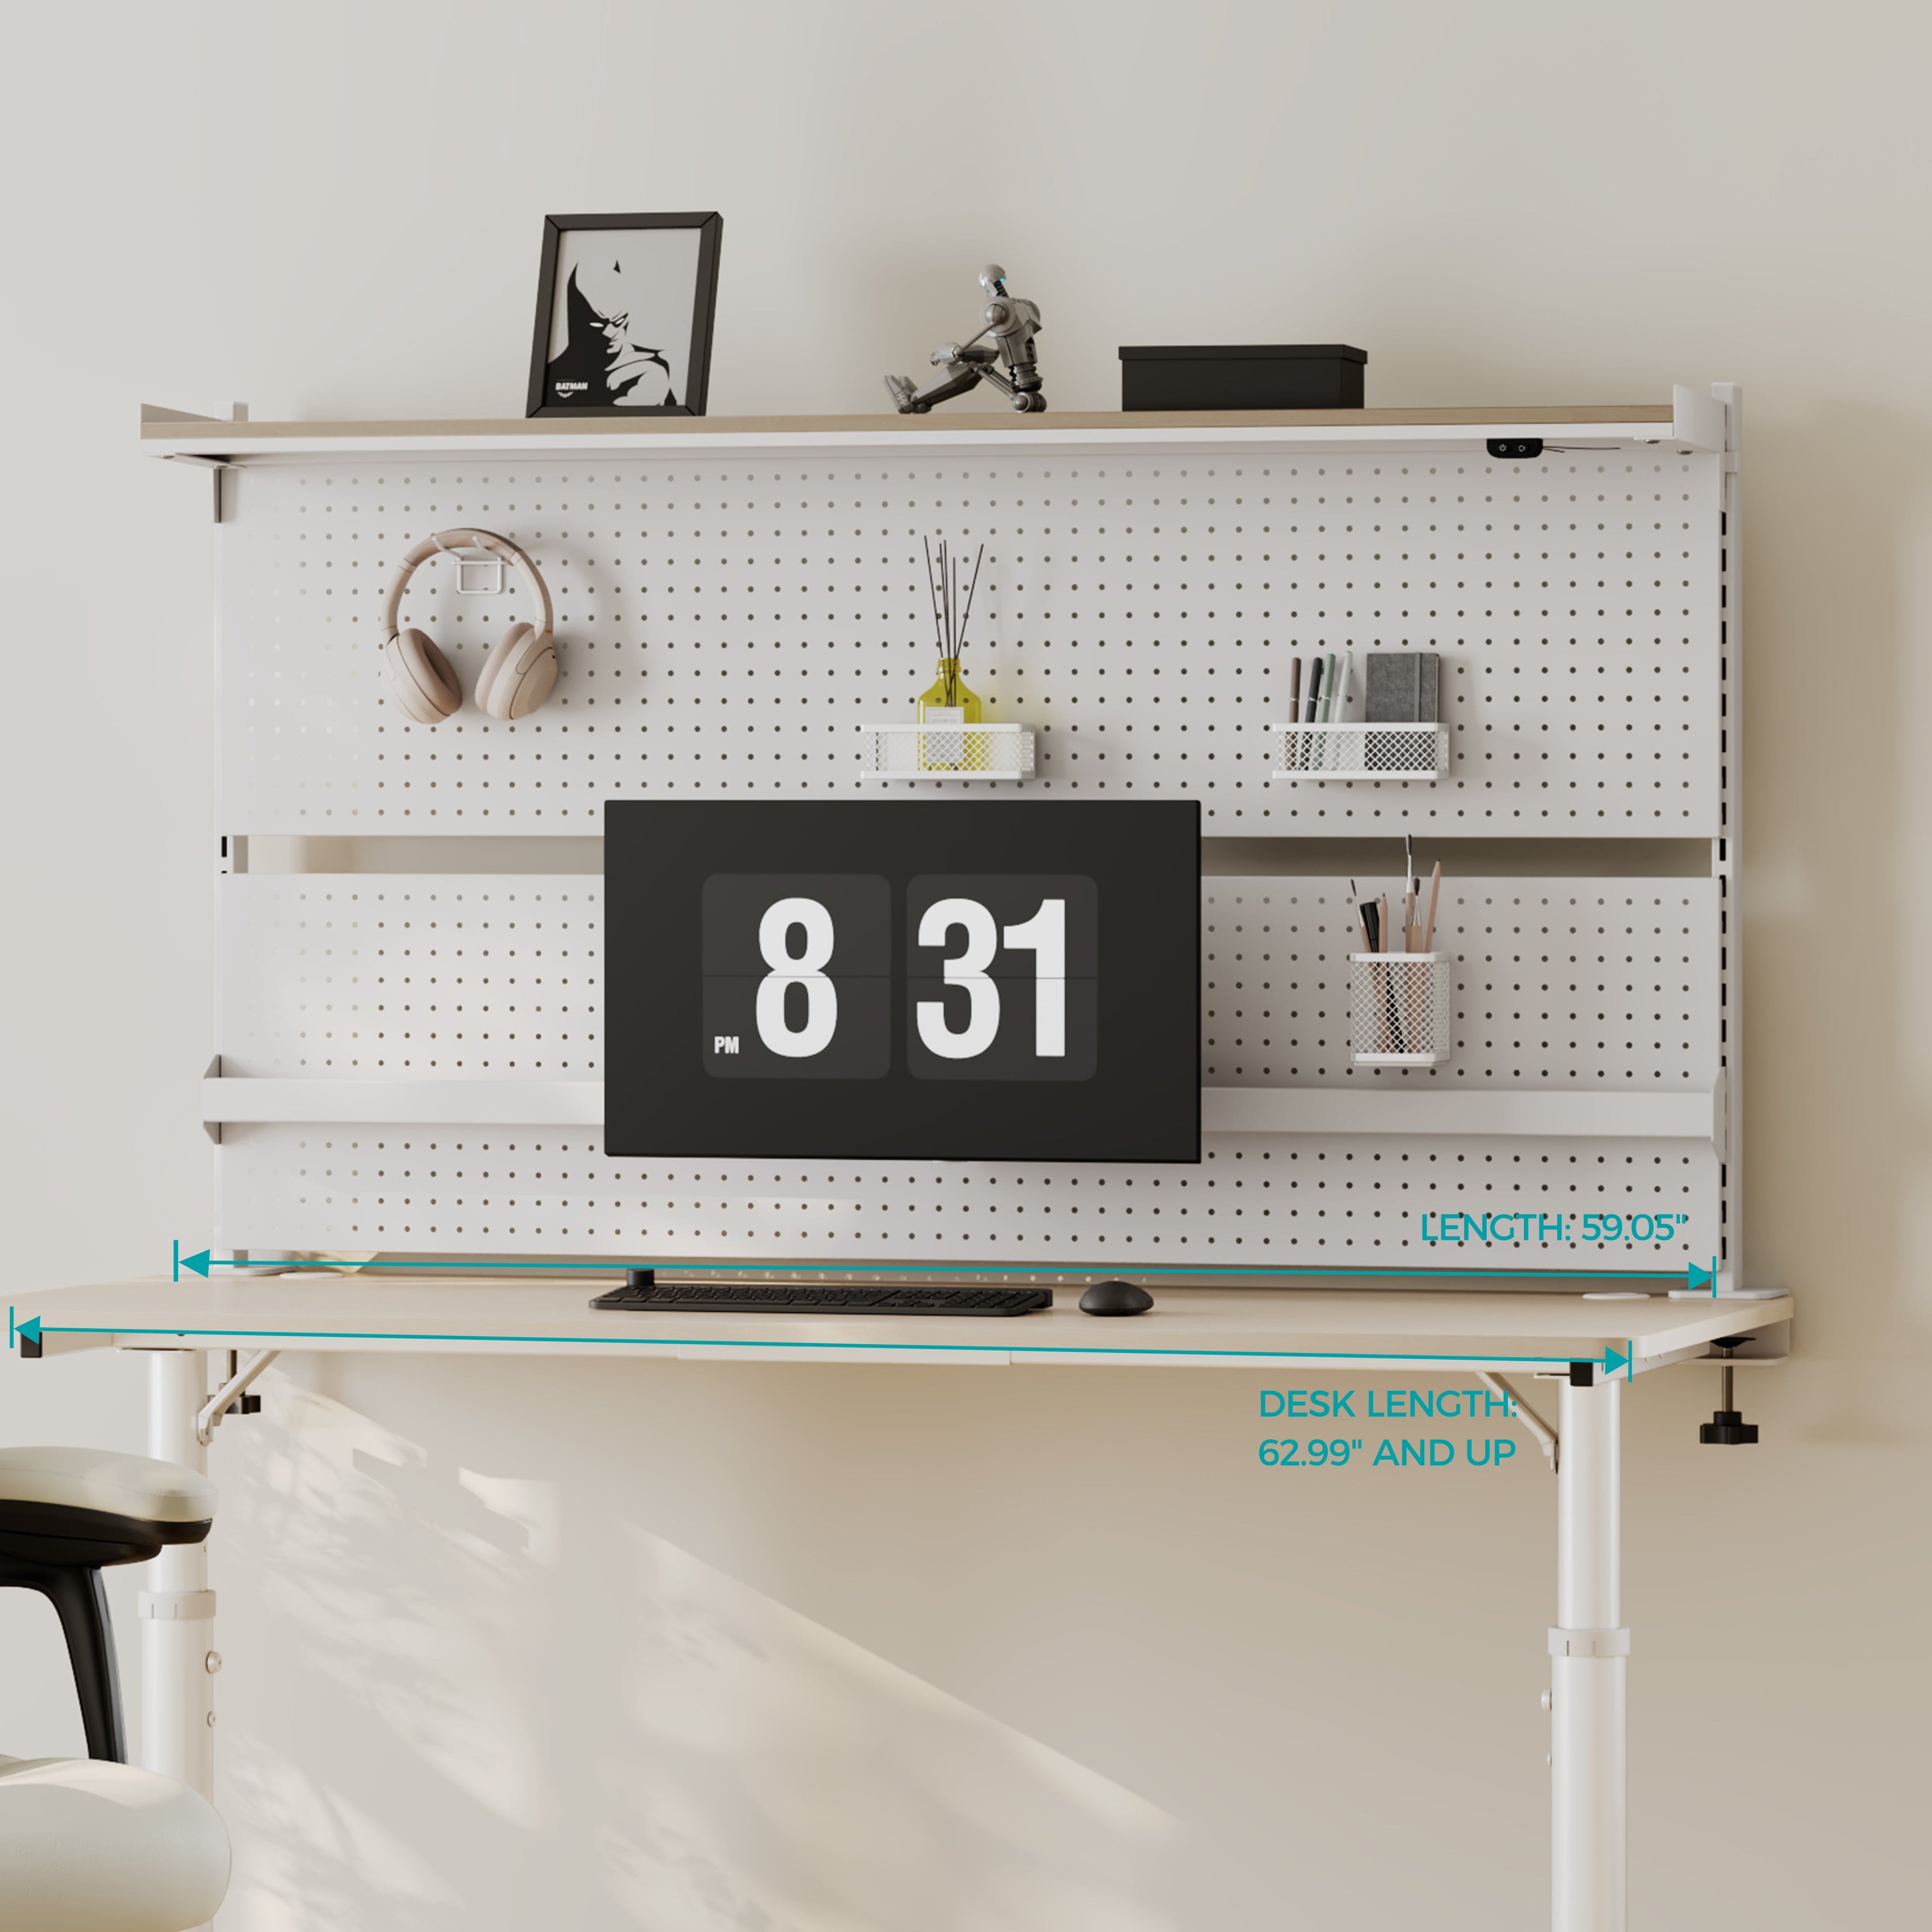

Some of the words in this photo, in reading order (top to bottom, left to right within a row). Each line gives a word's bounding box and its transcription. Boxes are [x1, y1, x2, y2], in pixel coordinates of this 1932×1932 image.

[555, 382, 588, 391] BATMAN
[756, 898, 837, 1058] 8
[917, 898, 1066, 1059] 31
[714, 1036, 739, 1054] PM
